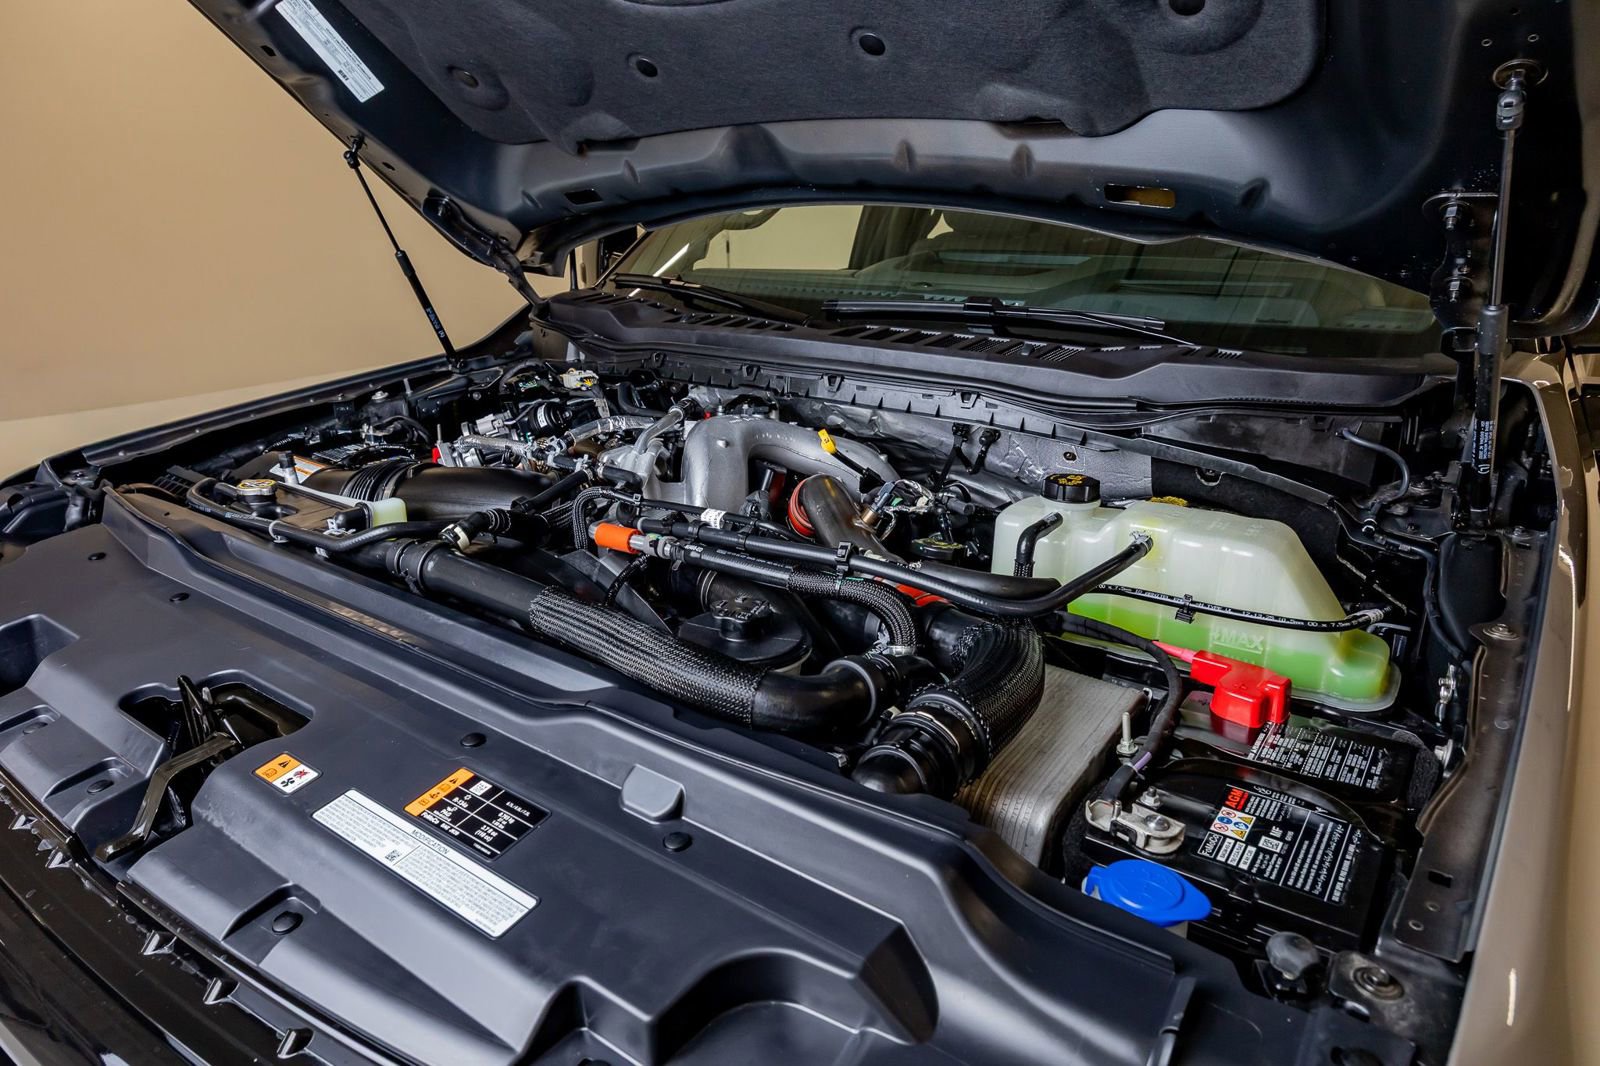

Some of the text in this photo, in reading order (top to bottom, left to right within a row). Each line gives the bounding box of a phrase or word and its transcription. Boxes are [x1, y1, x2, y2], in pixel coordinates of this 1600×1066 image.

[1224, 787, 1244, 809] AGM
[411, 829, 449, 854] MODIFICATION
[1201, 833, 1219, 856] FoMoCo
